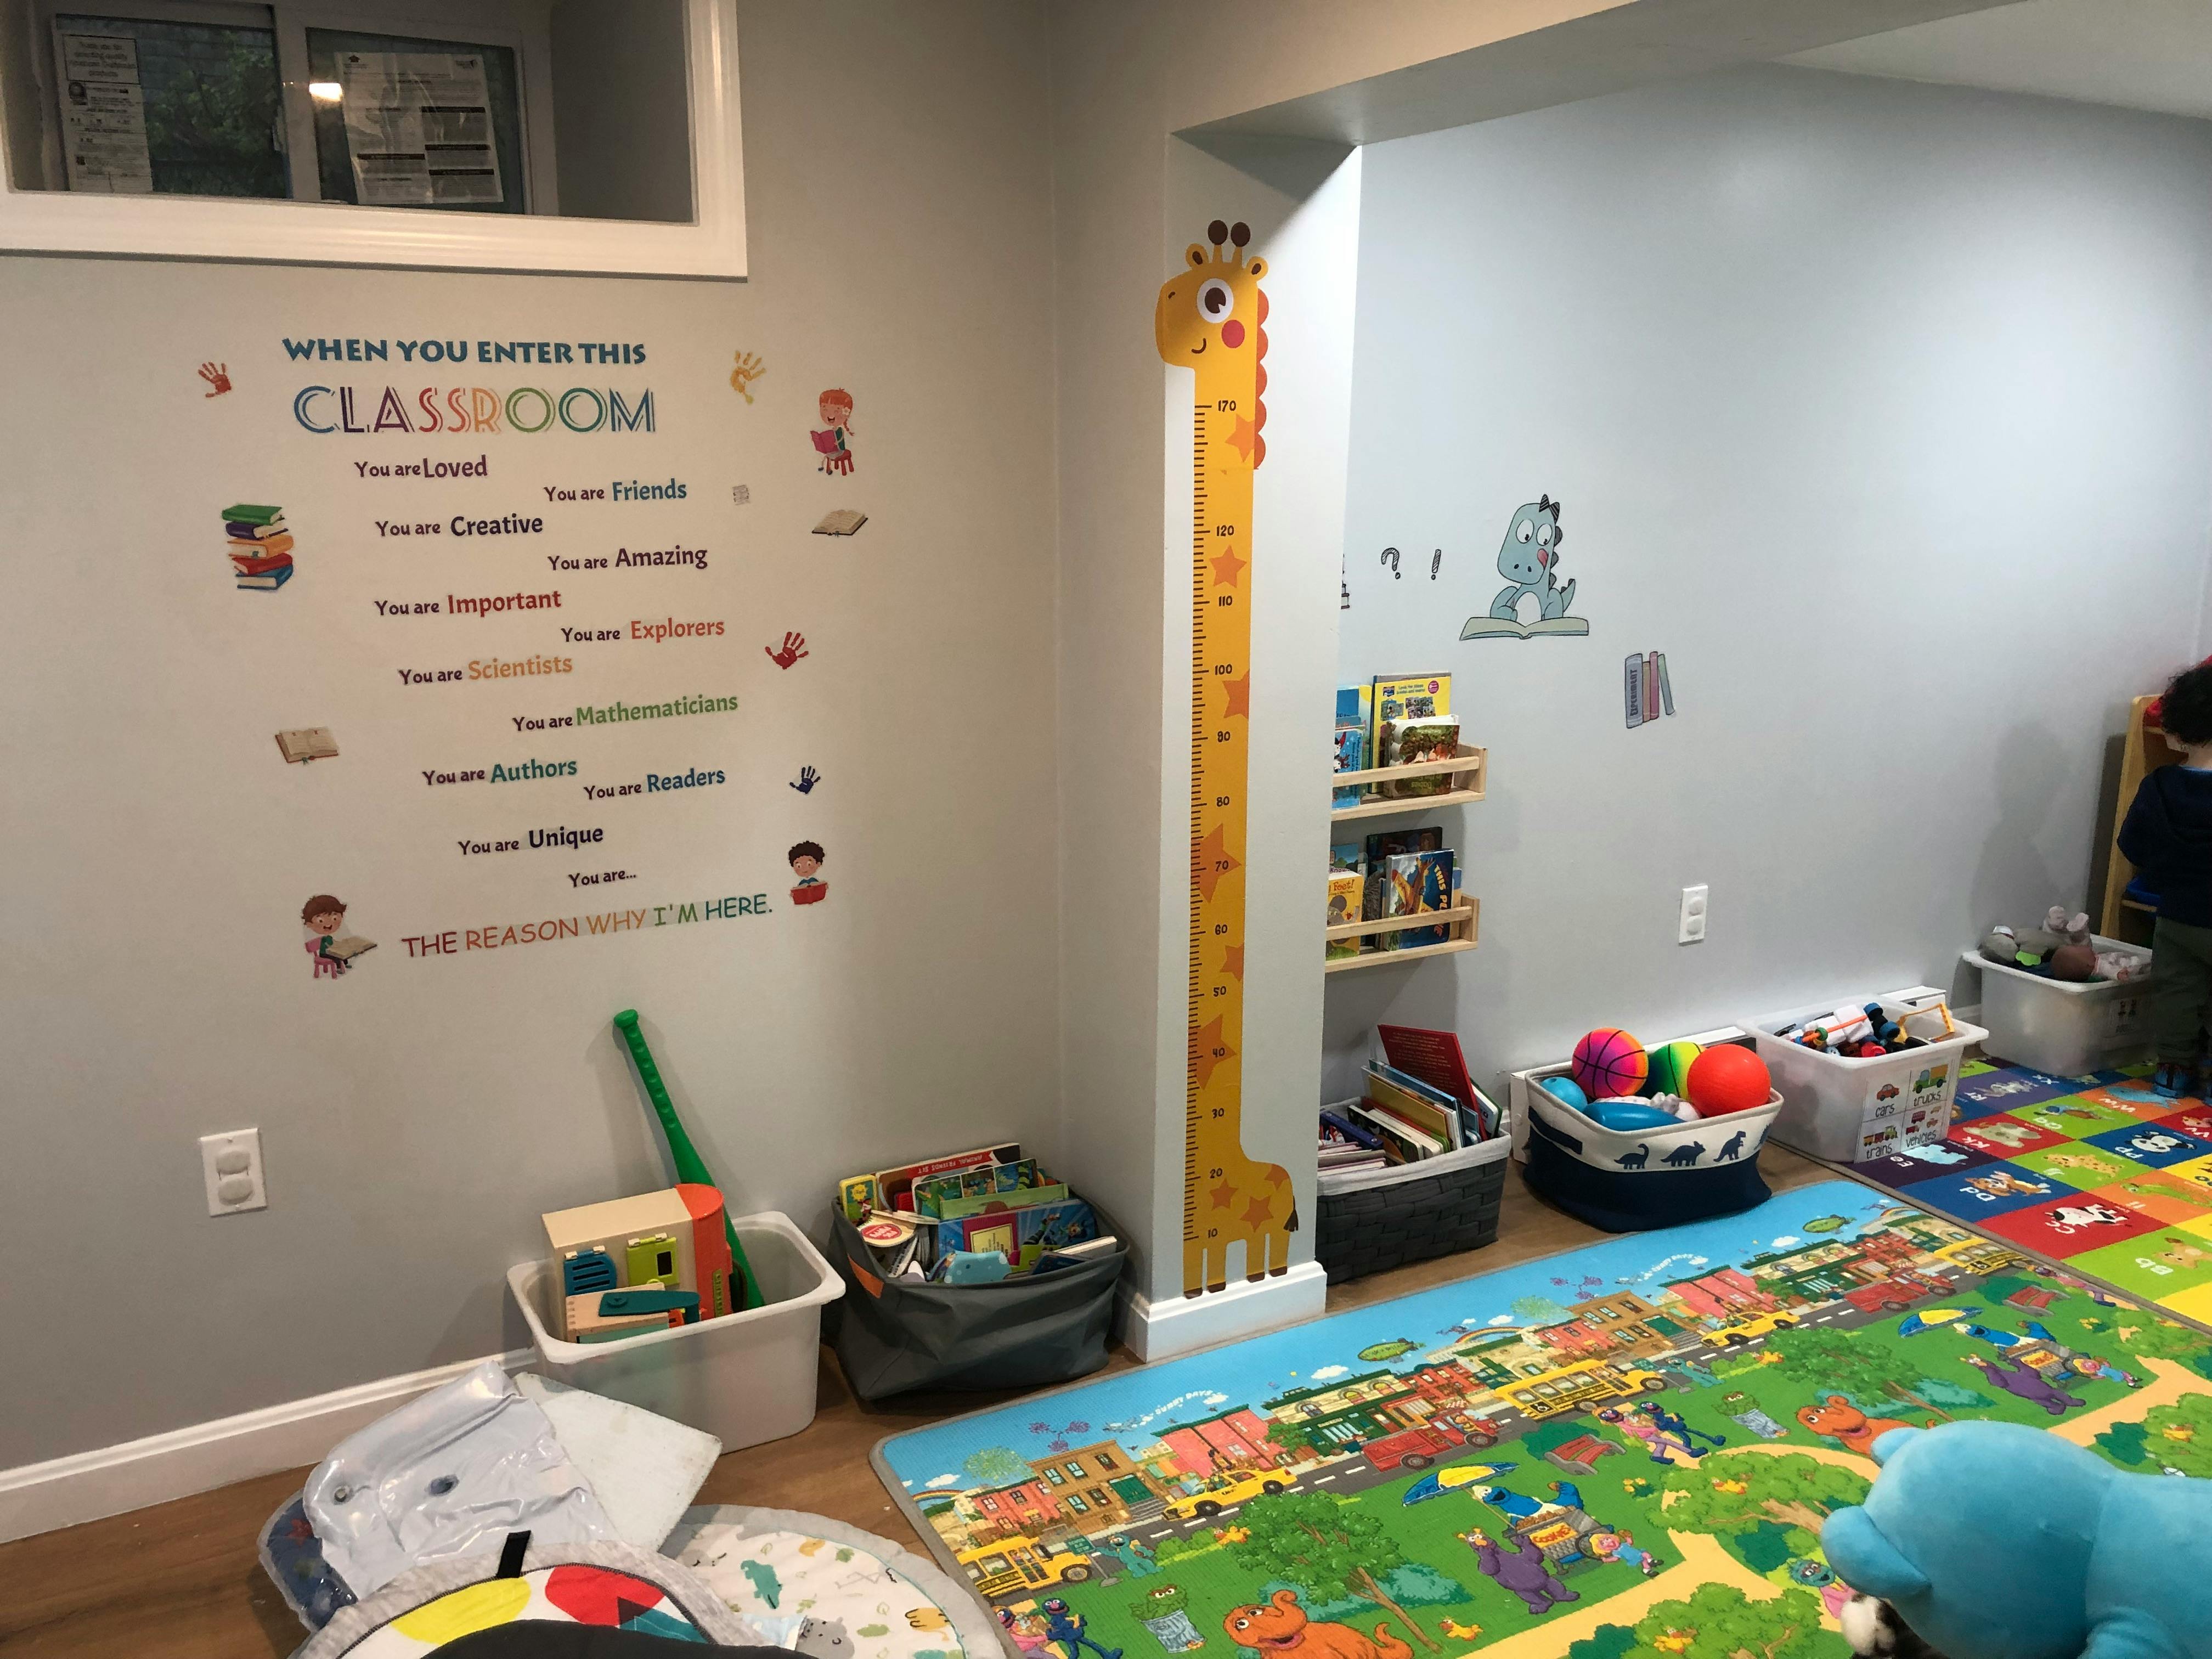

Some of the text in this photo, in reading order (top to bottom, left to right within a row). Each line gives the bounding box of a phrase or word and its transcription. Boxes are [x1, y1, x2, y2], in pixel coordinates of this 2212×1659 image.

[281, 338, 646, 365] WHEN YOU ENTER THIS
[293, 385, 656, 434] CLASSROOM
[1217, 400, 1237, 412] 170
[354, 454, 488, 478] You are Loved
[543, 478, 687, 502] You are Friends
[375, 513, 544, 538] You are Creative
[1216, 525, 1234, 537] 120
[547, 545, 708, 571] You are Amazing
[374, 591, 562, 618] You are Important
[1218, 595, 1233, 607] 110
[561, 617, 725, 644] You are Explorers
[398, 655, 572, 686] You are Scientists
[1214, 664, 1233, 675] 100
[1630, 669, 1638, 716] EXPERIMENT
[512, 694, 738, 732] You are Mathematicians
[1217, 731, 1231, 743] 90
[422, 758, 578, 786] You are Authors
[583, 767, 725, 800] You are Readers
[1216, 796, 1230, 806] 80
[458, 826, 603, 855] You are Unique
[1215, 860, 1229, 871] 70
[567, 871, 637, 888] You are...
[1333, 879, 1355, 891] Feet!
[1434, 865, 1446, 890] THIS
[400, 894, 772, 958] THE REASON WHY I'M HERE.
[1214, 924, 1228, 935] 60
[1212, 986, 1227, 997] 50
[1212, 1047, 1226, 1058] 40
[1914, 1091, 1941, 1107] trucks
[1211, 1108, 1224, 1119] 30
[1875, 1103, 1895, 1117] cars
[1906, 1130, 1936, 1147] vehicles
[1866, 1143, 1892, 1159] trains
[917, 1154, 983, 1174] ANIMAL FRIENDS SET
[1210, 1167, 1223, 1178] 20
[1960, 1186, 1996, 1201] Dd
[1207, 1228, 1218, 1238] 10
[1533, 1525, 1571, 1543] COOKIES
